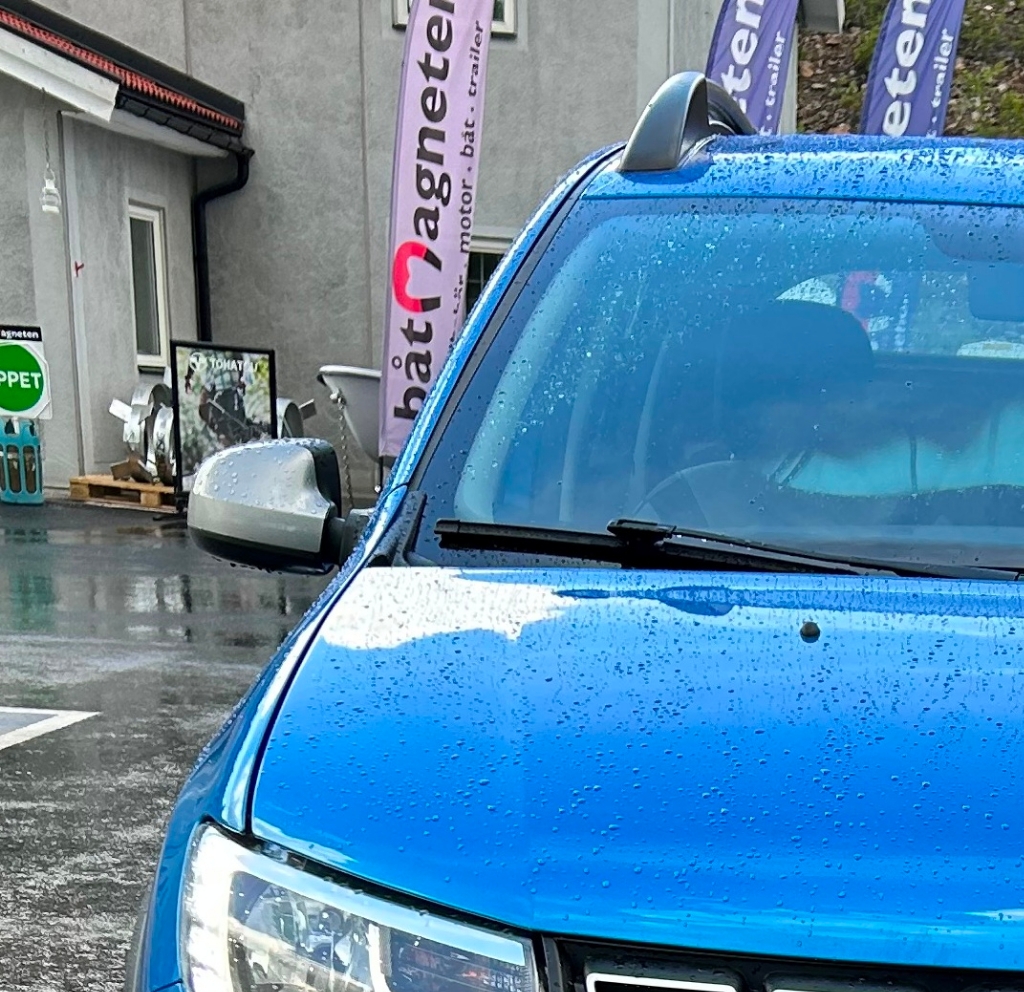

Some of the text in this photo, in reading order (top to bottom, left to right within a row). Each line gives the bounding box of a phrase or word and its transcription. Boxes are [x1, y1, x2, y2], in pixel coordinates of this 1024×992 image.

[765, 30, 786, 107] trailer
[931, 27, 954, 108] trailer
[459, 20, 484, 254] motor båt trailer
